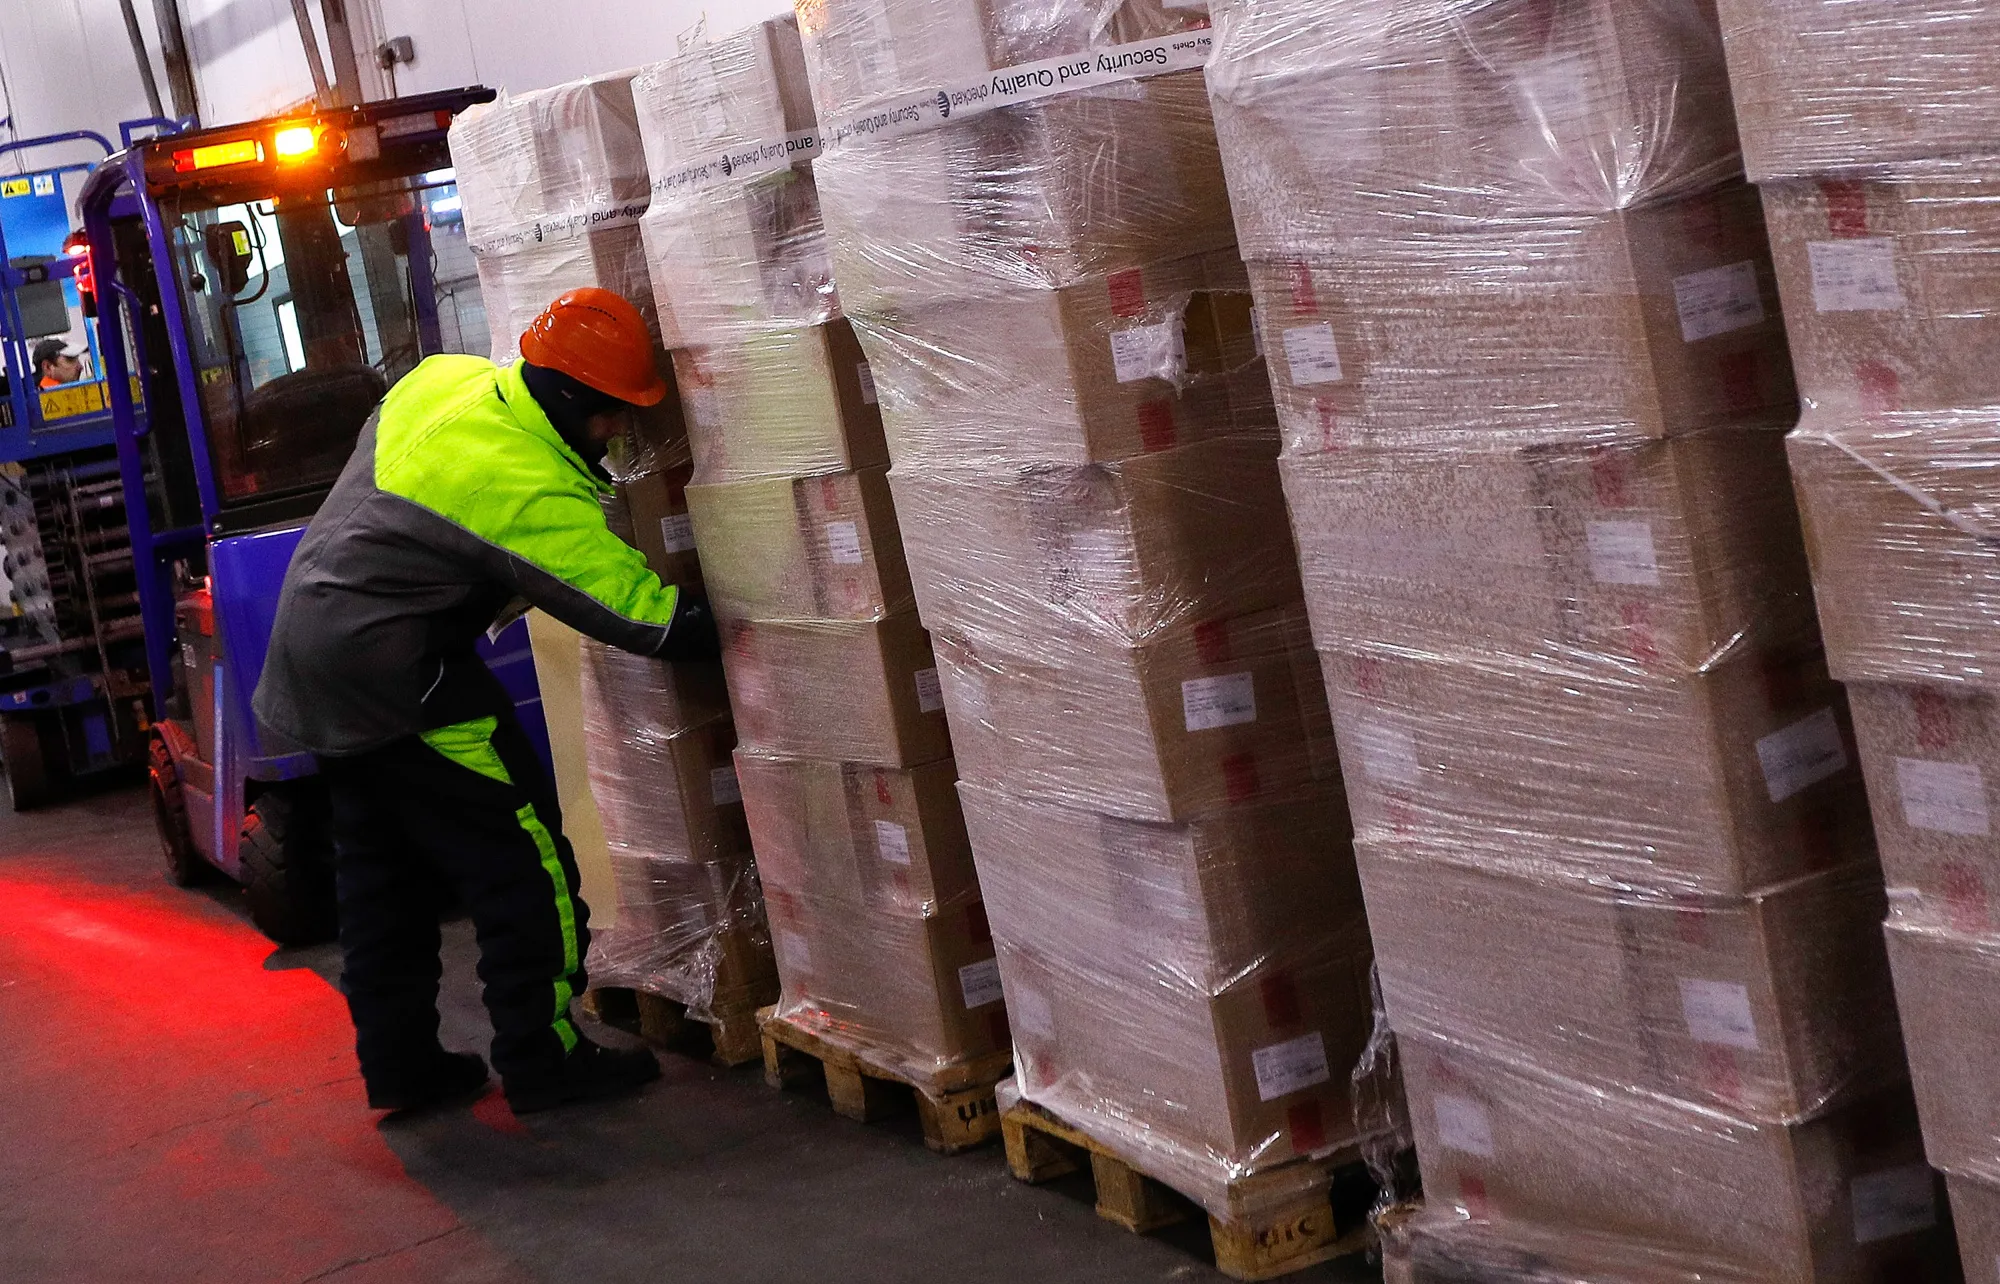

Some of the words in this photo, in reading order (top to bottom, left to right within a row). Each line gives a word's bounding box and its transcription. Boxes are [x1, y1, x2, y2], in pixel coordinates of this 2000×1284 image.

[1172, 40, 1196, 51] Chefs
[1196, 37, 1213, 46] Sky
[1096, 47, 1168, 73] Security
[1058, 61, 1091, 83] and
[991, 70, 1054, 95] Quality
[951, 84, 988, 109] checked
[873, 113, 888, 132] and
[889, 105, 920, 125] Security
[760, 144, 785, 162] Quality
[786, 136, 814, 156] and
[592, 209, 617, 225] and
